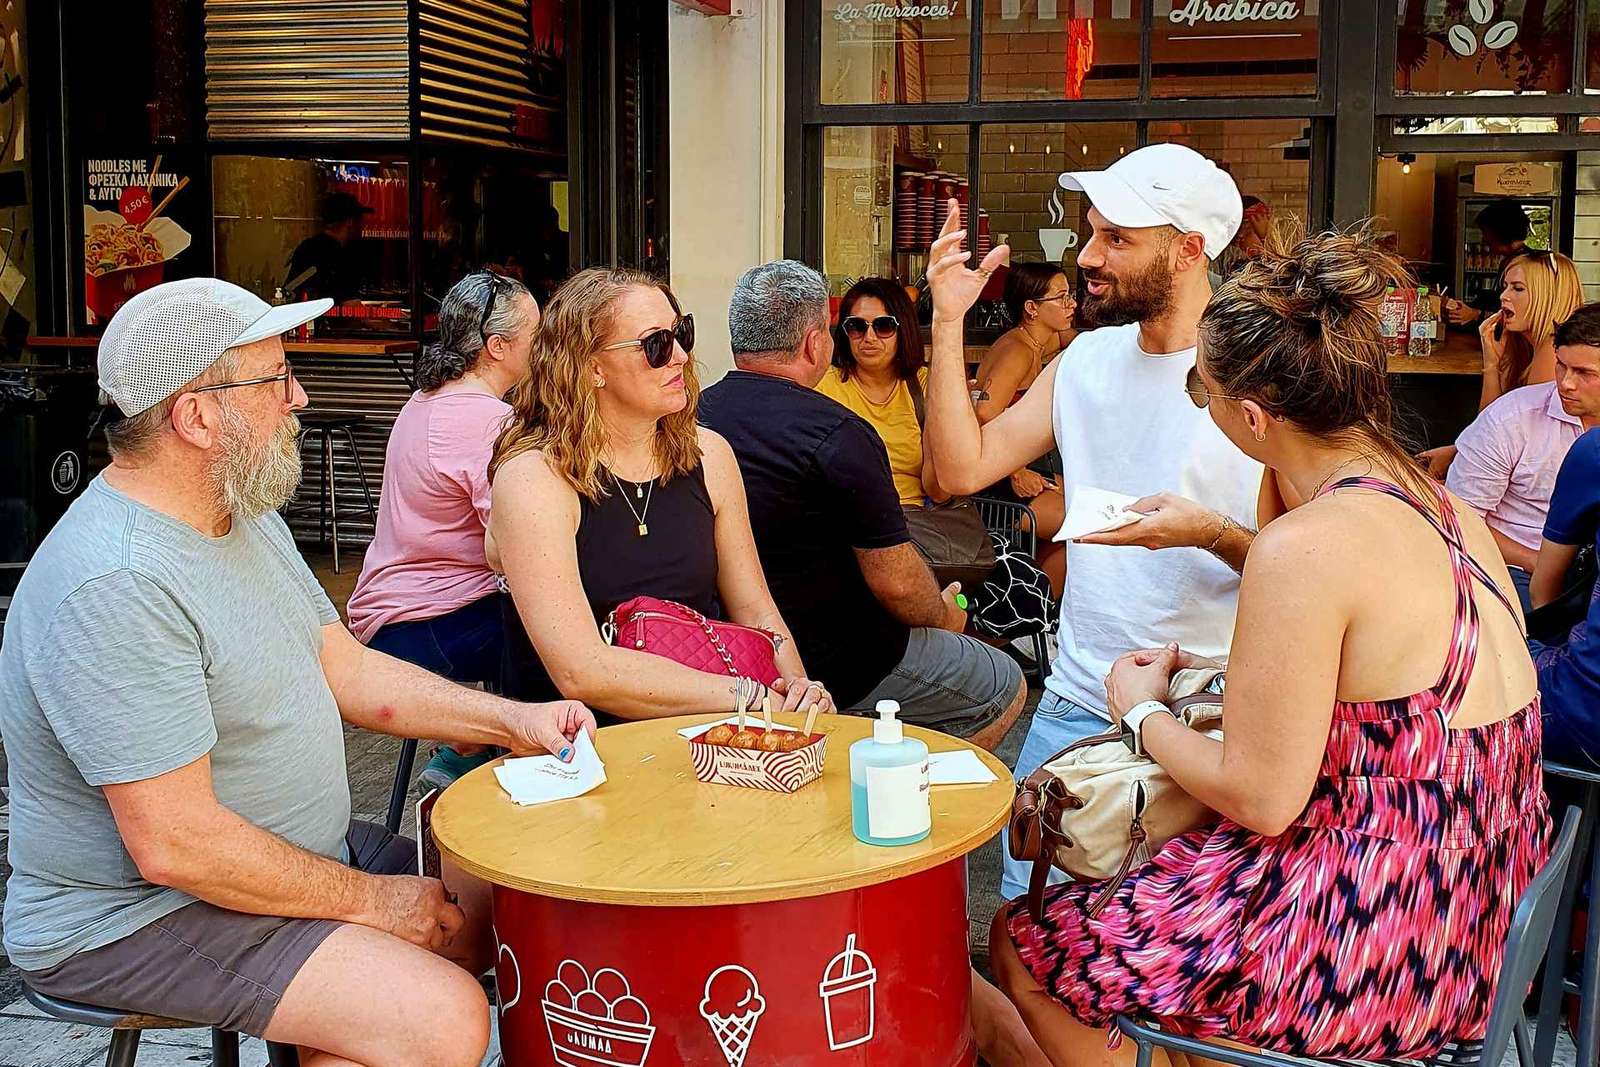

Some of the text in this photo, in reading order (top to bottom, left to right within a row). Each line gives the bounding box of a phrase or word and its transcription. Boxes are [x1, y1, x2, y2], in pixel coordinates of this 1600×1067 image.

[834, 1, 958, 23] La Marzocco!
[1169, 0, 1300, 26] Arabica
[88, 160, 131, 173] NOODLES
[88, 173, 179, 187] ΦΡΕΣΚΑ ΛΑΧΑΝΙΚΑ
[89, 187, 122, 201] & ΑΥΓΟ
